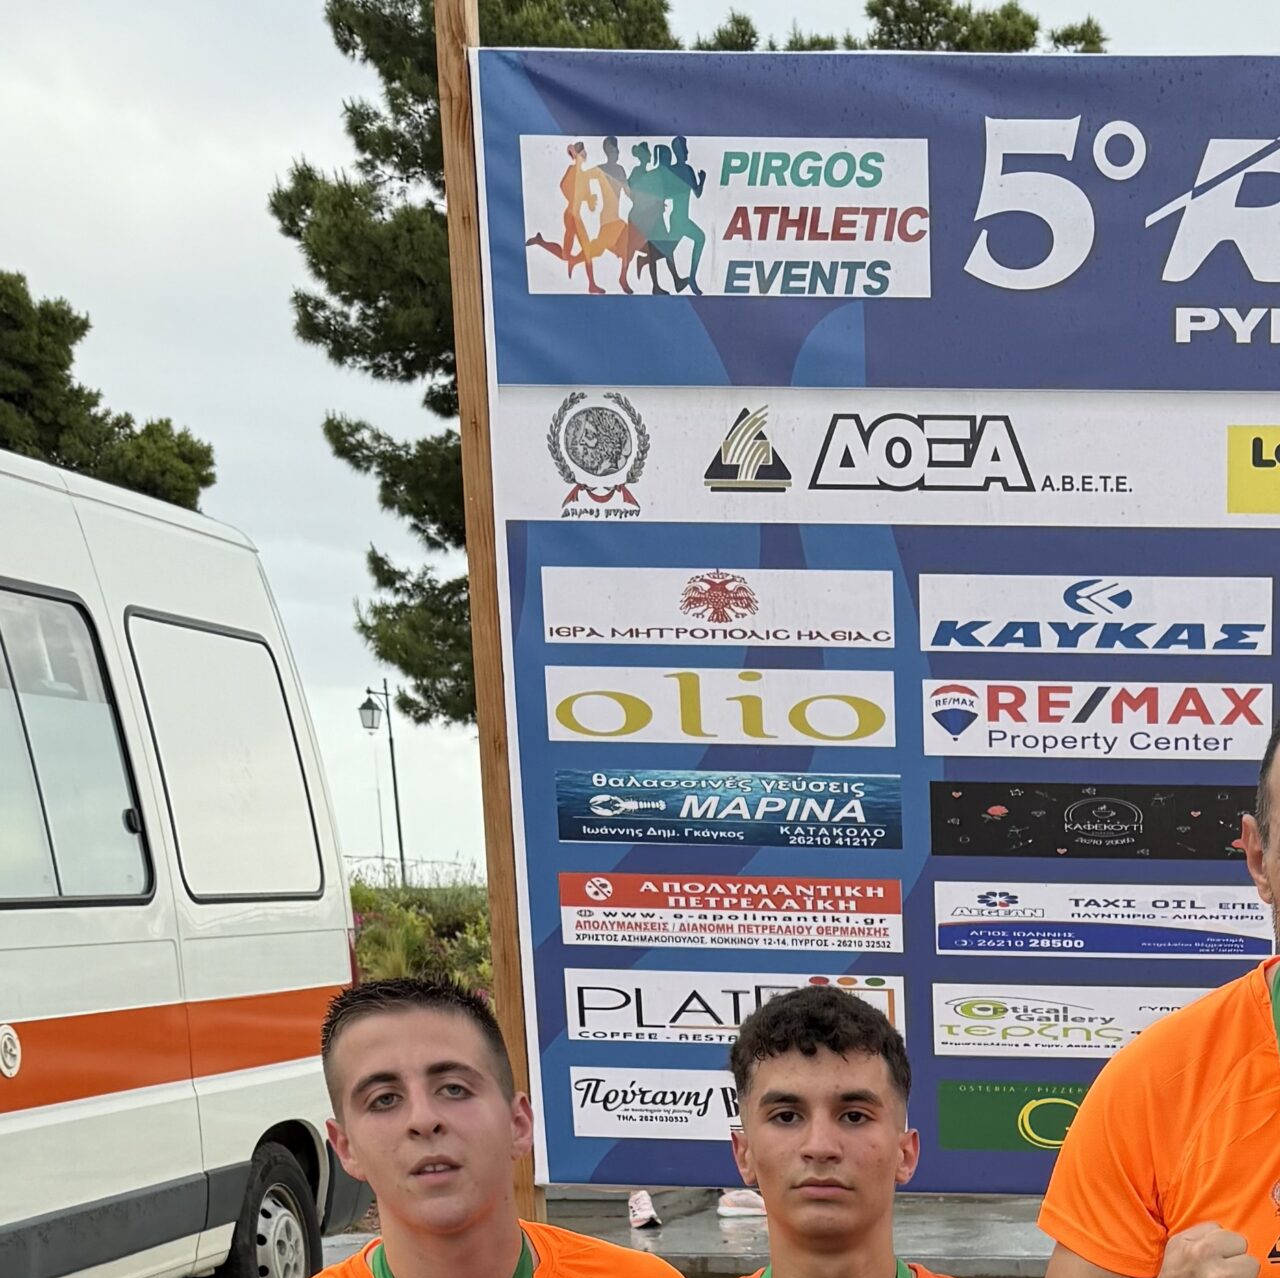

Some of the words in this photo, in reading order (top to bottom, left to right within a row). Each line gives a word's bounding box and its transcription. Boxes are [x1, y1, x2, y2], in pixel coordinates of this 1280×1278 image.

[719, 150, 885, 187] PIRGOS
[722, 205, 930, 243] ATHLETIC
[724, 260, 890, 296] EVENTS
[808, 413, 1036, 491] ΔΟΞΑ
[931, 620, 1266, 650] ΚΑΥΚΑΣ
[555, 670, 886, 741] olio
[986, 684, 1264, 726] RE/MAX
[988, 729, 1118, 755] Property
[1129, 731, 1233, 752] Center
[592, 773, 752, 792] θαλασσινές
[761, 776, 866, 797] γεύσεις
[679, 795, 866, 823] ΜΑΡΙΝΑ
[582, 825, 643, 838] Ιωάννης
[646, 826, 680, 839] Δημ.
[684, 827, 745, 841] Γκάγκος
[780, 825, 886, 838] ΚΑΤΑΚΟΛΟ
[789, 836, 831, 846] 26210
[835, 836, 877, 847] 41217
[639, 880, 885, 898] ΑΠΟΛΥΜΑΝΤΙΚΗ
[951, 906, 1045, 918] AEGEAN
[1069, 898, 1136, 909] TAXI
[1151, 899, 1206, 910] OIL
[1071, 912, 1156, 921] ΠΛΥΝΤΗΡΙΟ
[1172, 913, 1265, 922] ΛΙΠΑΝΤΗΡΙΟ
[575, 920, 669, 932] ΑΠΟΛΥΜΑΝΣΕΙΣ
[679, 922, 735, 934] ΔΙΑΝΟΜΗ
[737, 923, 814, 936] ΠΕΤΡΕΛΑΙΟΥ
[816, 925, 889, 937] ΘΕΡΜΑΝΣΗΣ
[970, 930, 1008, 938] ΑΓΙΟΣ
[1012, 930, 1075, 938] ΙΩΑΝΝΗΣ
[575, 933, 619, 943] ΧΡΗΣΤΟΣ
[711, 936, 760, 946] ΚΟΚΚΙΝΟΥ
[791, 938, 829, 948] ΠΥΡΓΟΣ
[837, 939, 863, 948] 26210
[977, 939, 1024, 948] 26210
[1029, 938, 1084, 949] 28500
[1015, 1014, 1115, 1025] Gallery
[959, 1085, 1015, 1093] OSTERIA
